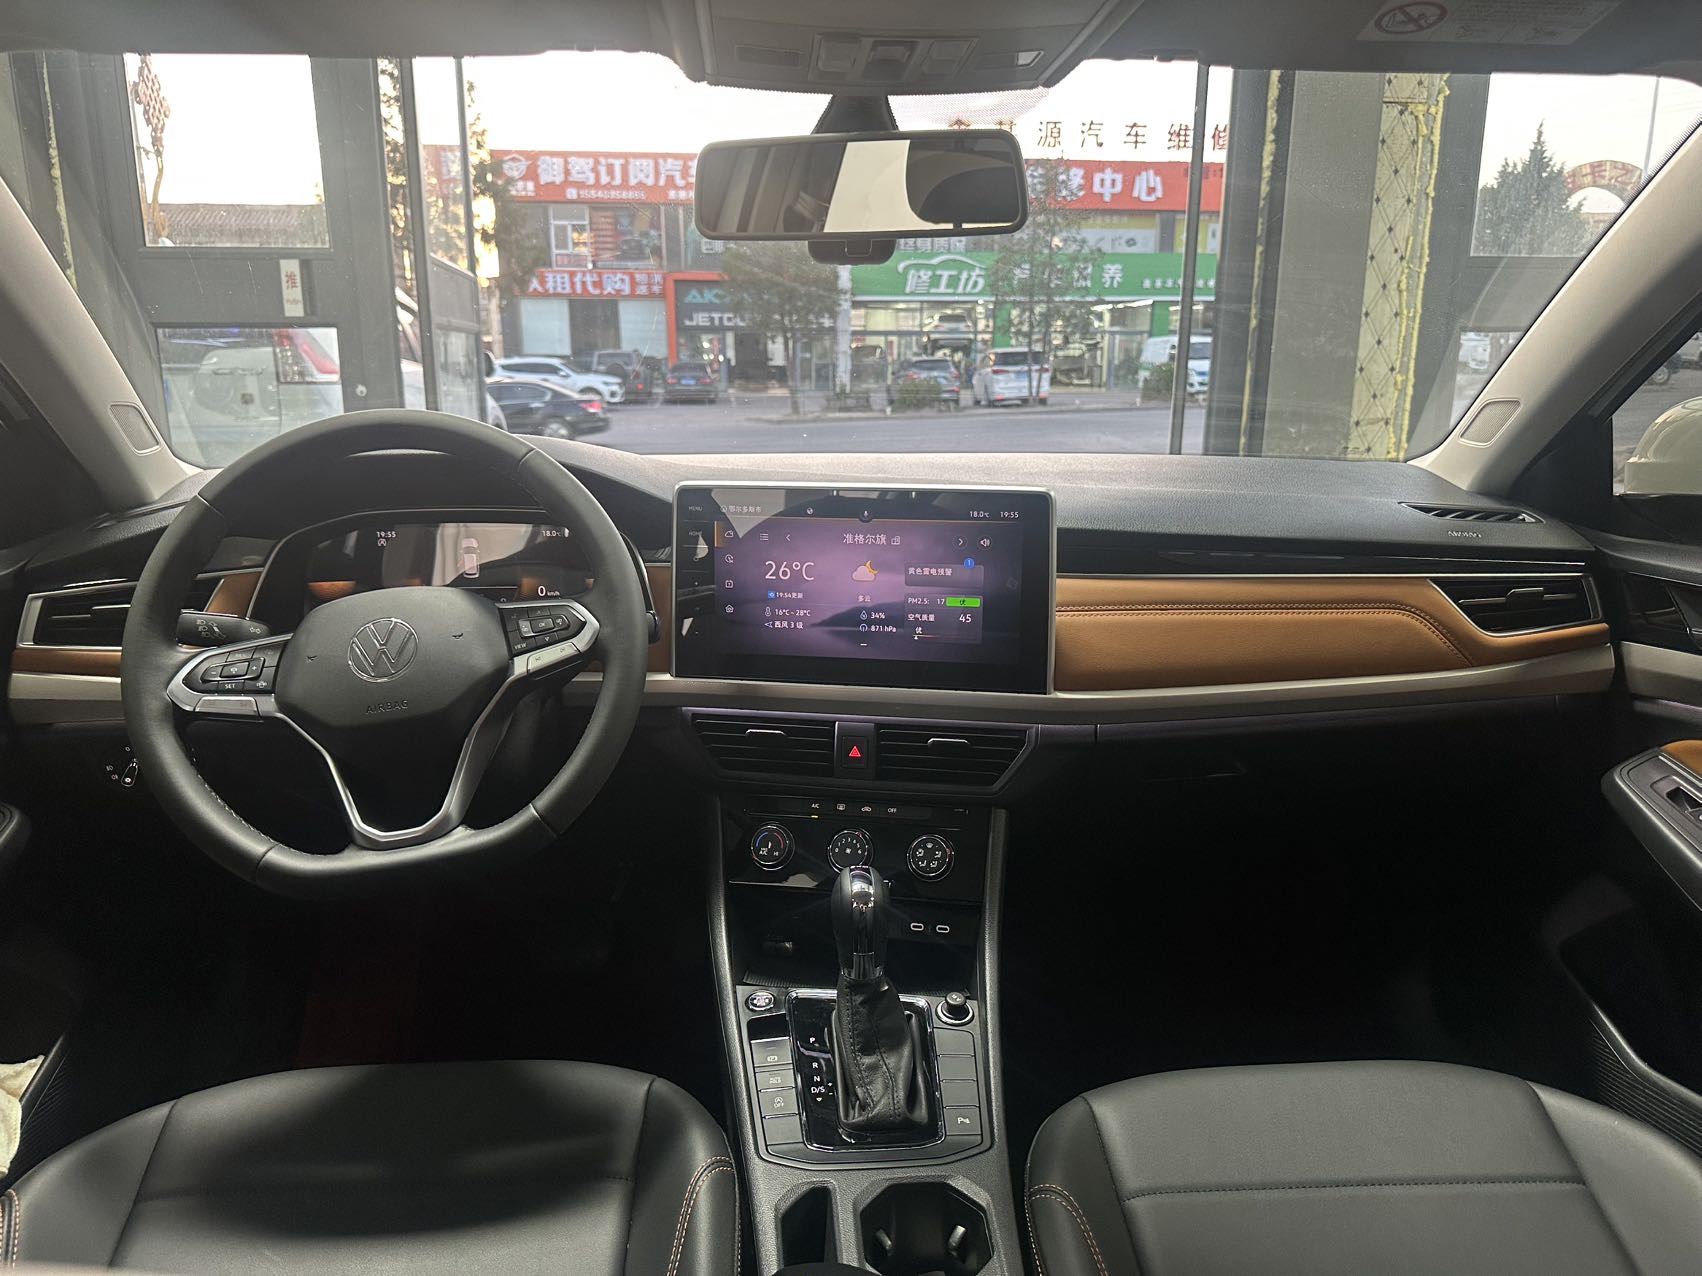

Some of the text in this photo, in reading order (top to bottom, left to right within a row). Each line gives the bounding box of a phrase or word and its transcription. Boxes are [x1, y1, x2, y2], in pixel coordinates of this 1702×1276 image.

[1000, 511, 1019, 519] 19:55
[843, 533, 887, 545] 准格尔旗
[537, 585, 546, 596] 0
[870, 611, 885, 619] 34%
[907, 613, 935, 622] 空气质量
[959, 614, 972, 623] 45
[365, 699, 409, 714] AIRBAG
[811, 1086, 825, 1094] D/S
